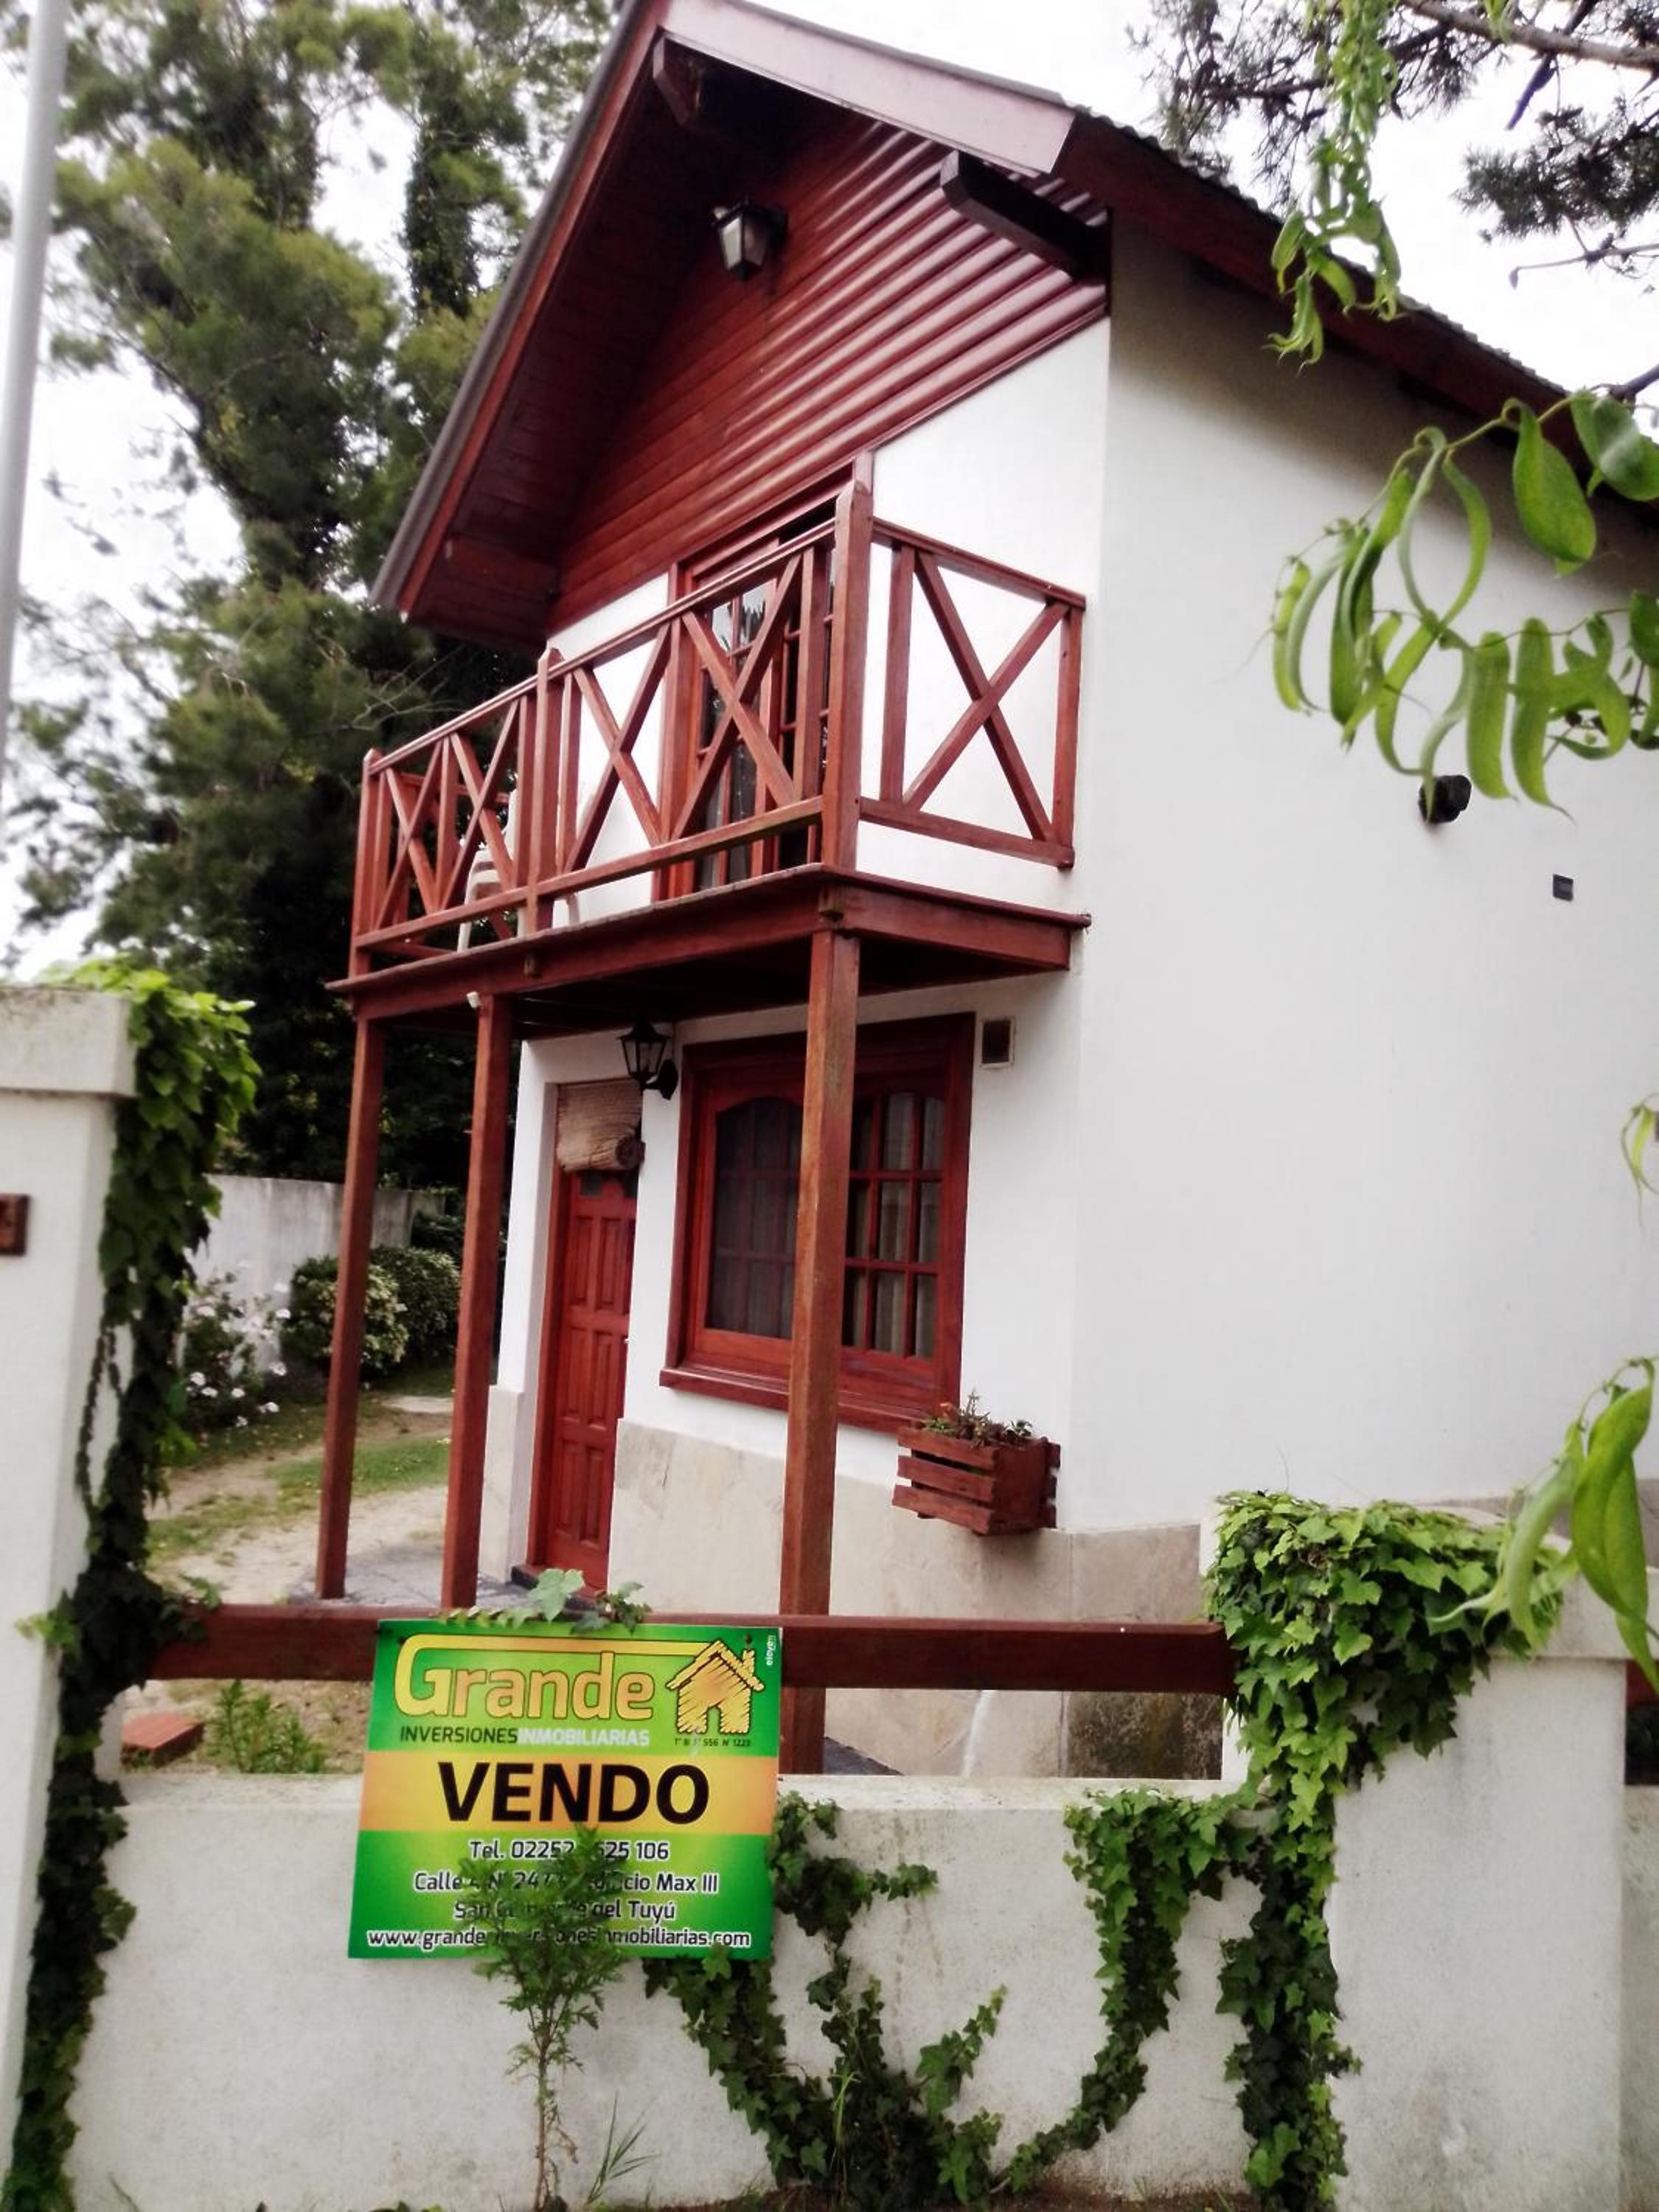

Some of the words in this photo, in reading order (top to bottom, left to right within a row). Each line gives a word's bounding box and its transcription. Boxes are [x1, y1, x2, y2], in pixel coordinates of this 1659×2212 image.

[394, 1634, 655, 1720] Grande
[437, 1761, 710, 1825] VENDO
[470, 1840, 504, 1859] Tel.
[636, 1842, 669, 1860] 106
[415, 1871, 462, 1891] Calle
[656, 1874, 697, 1892] Max
[703, 1875, 718, 1893] III
[628, 1901, 675, 1924] Tuyú
